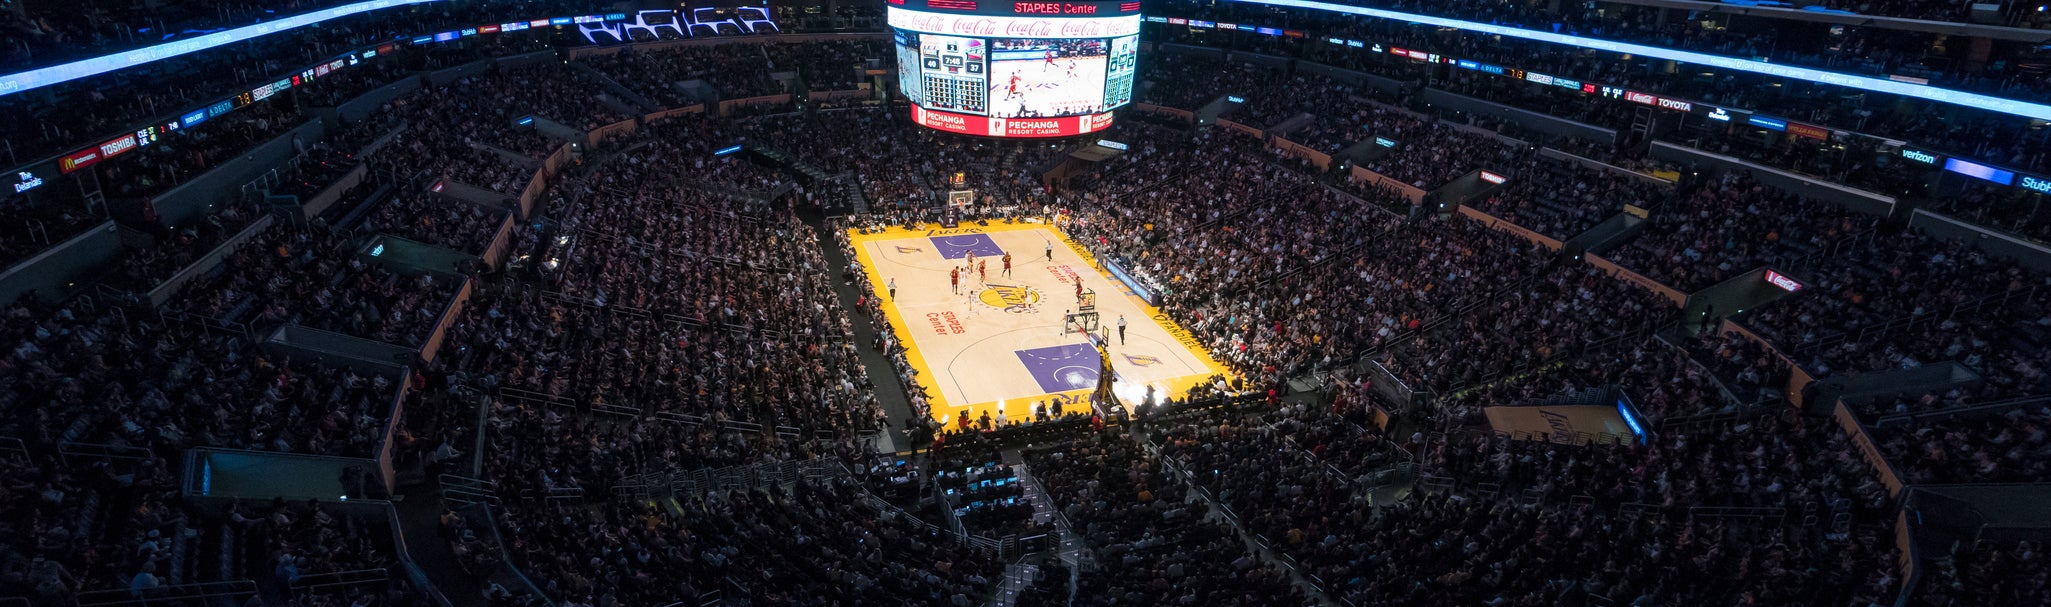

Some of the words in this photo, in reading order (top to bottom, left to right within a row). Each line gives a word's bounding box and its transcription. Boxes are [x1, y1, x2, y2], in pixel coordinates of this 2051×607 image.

[1014, 3, 1060, 14] STAPLES
[1063, 3, 1097, 14] Center
[927, 60, 937, 68] 40
[945, 57, 960, 65] 7:48
[970, 64, 980, 72] 37
[1527, 72, 1552, 84] STAPLES
[253, 84, 273, 100] STAPLES
[214, 101, 232, 114] DELTA
[1658, 98, 1691, 112] TOYOTA
[927, 112, 965, 125] PECHANGA
[927, 120, 943, 128] RESORT
[1008, 120, 1059, 129] PECHANGA
[100, 136, 136, 156] TOSHIBA
[1902, 149, 1934, 164] verizon
[18, 171, 33, 180] The
[926, 312, 948, 335] Center
[941, 310, 966, 335] STAPLES
[1161, 320, 1198, 350] FANDUEL
